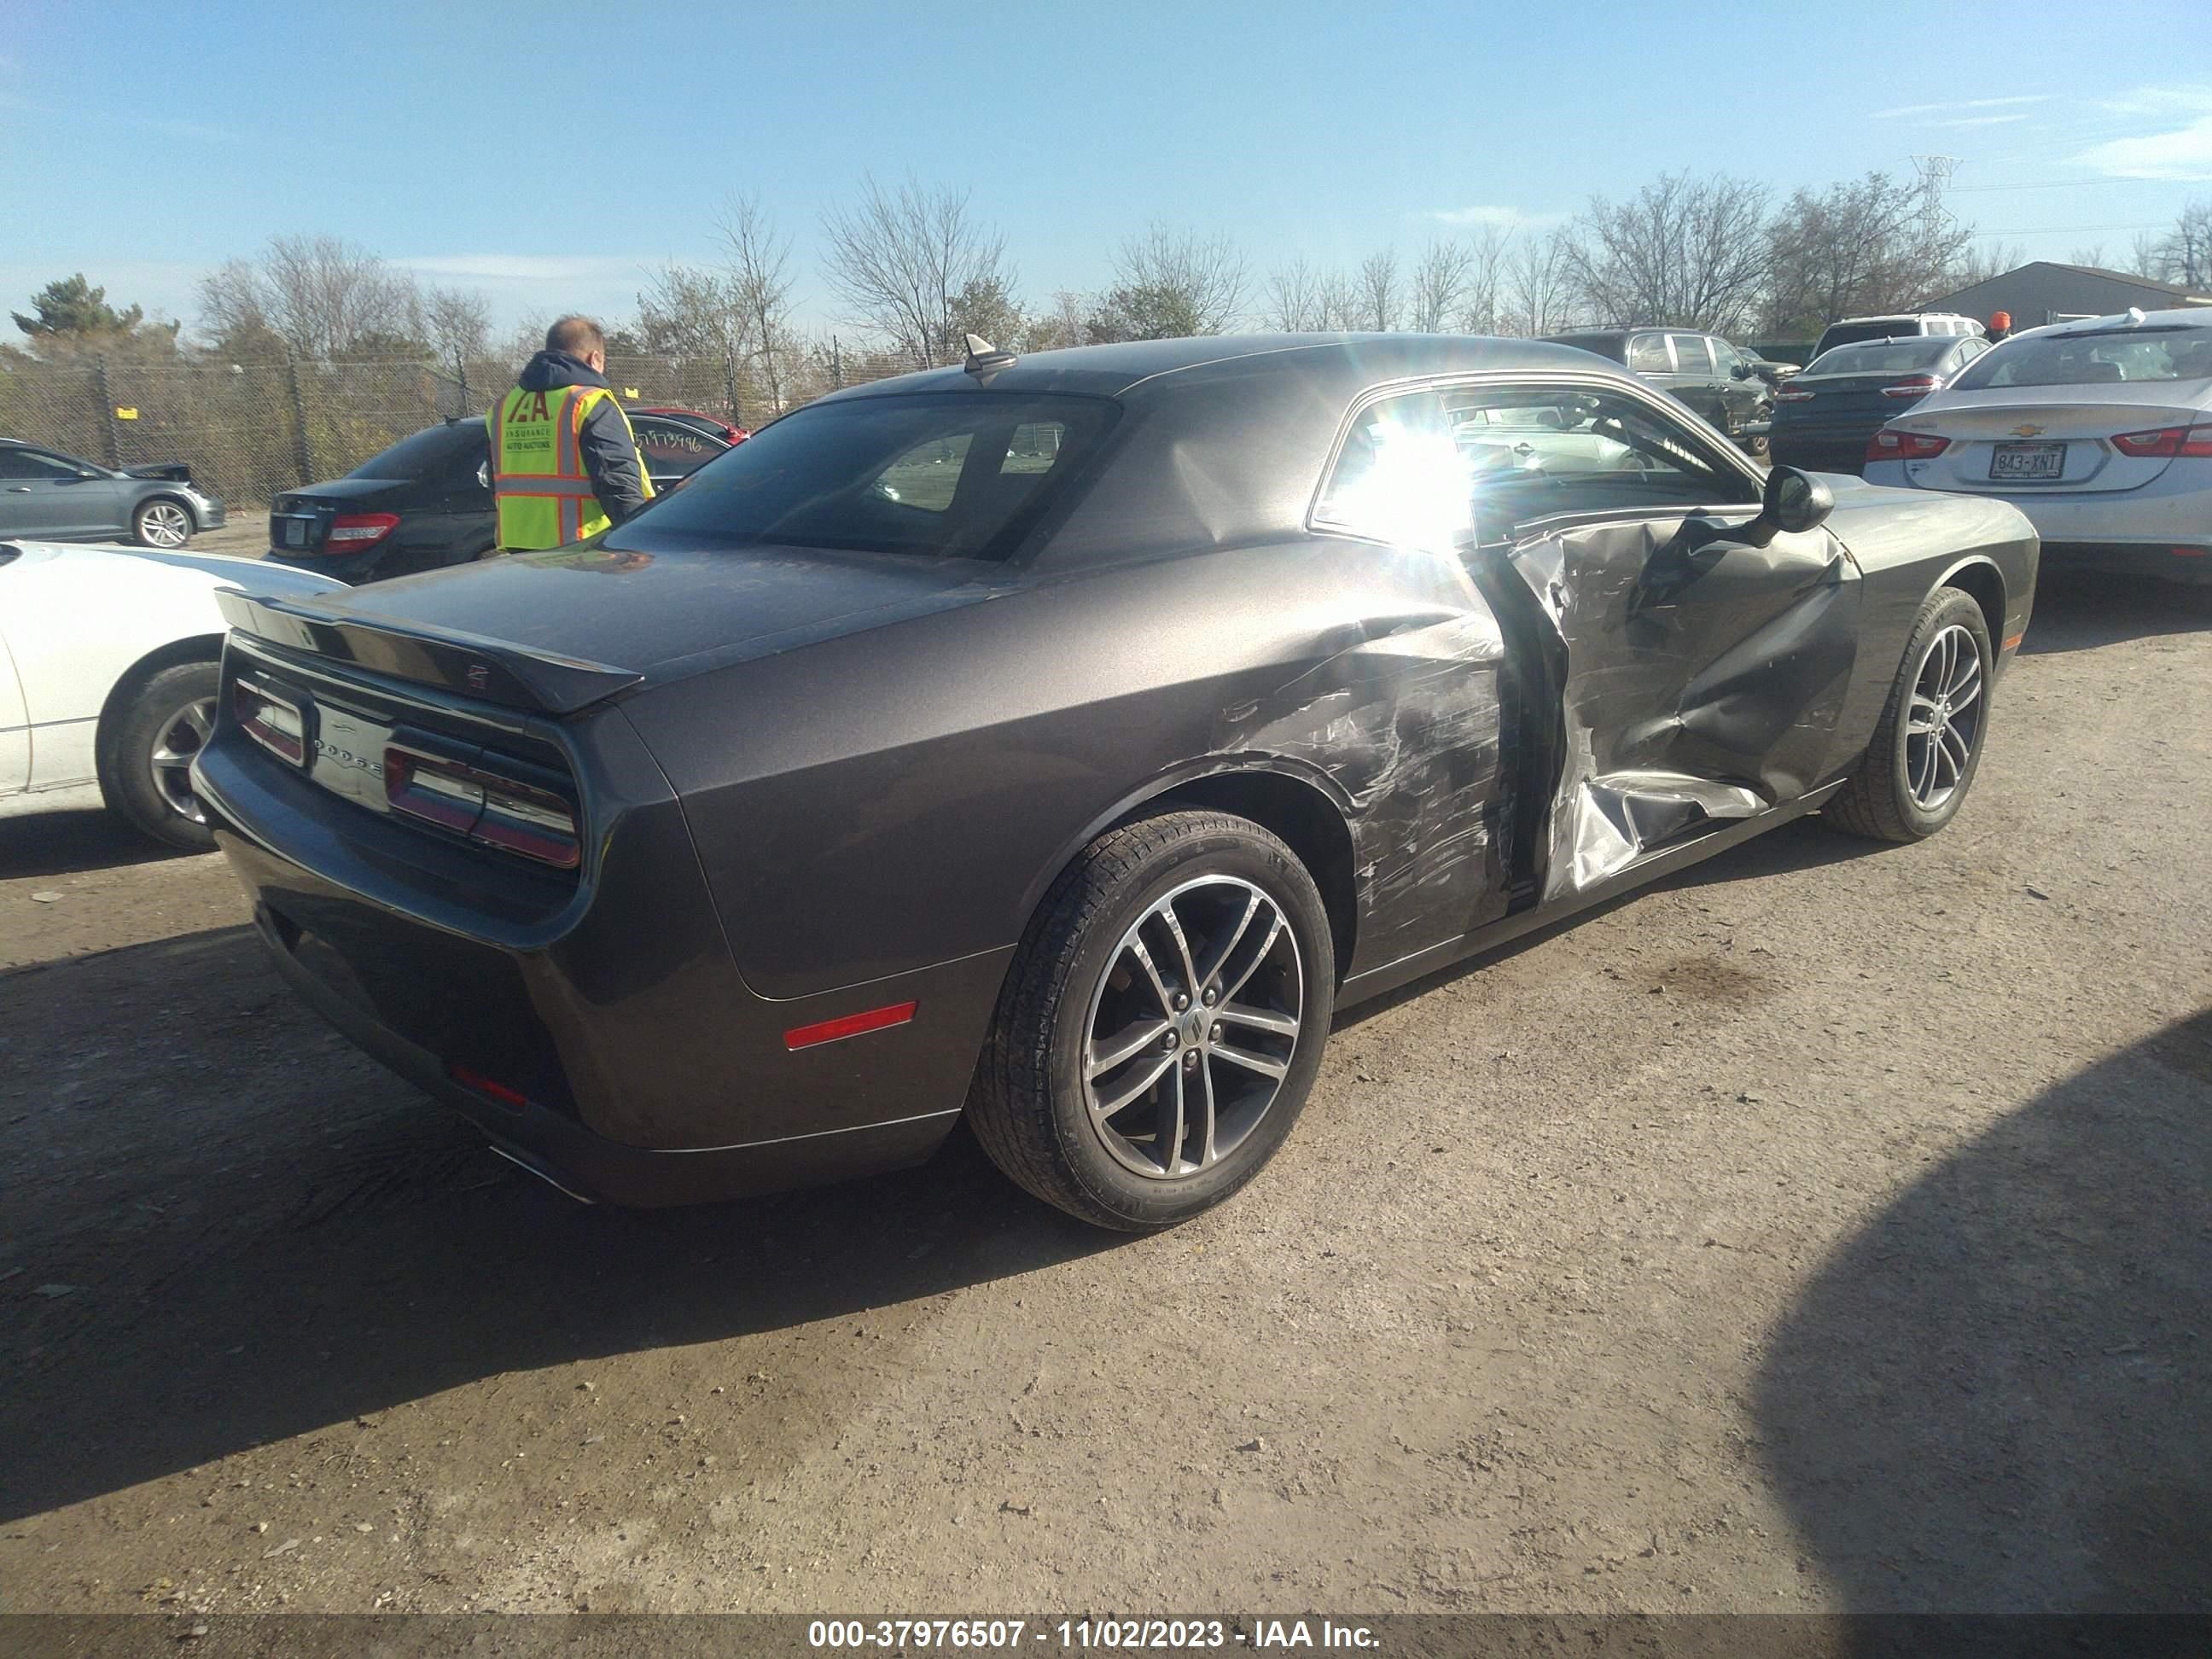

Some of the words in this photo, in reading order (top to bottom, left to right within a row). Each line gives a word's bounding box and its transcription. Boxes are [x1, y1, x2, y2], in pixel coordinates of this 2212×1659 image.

[505, 428, 551, 438] INSURANCE
[505, 442, 522, 451] AUTO
[523, 440, 551, 450] AUCTIONS
[314, 739, 382, 773] DODGE
